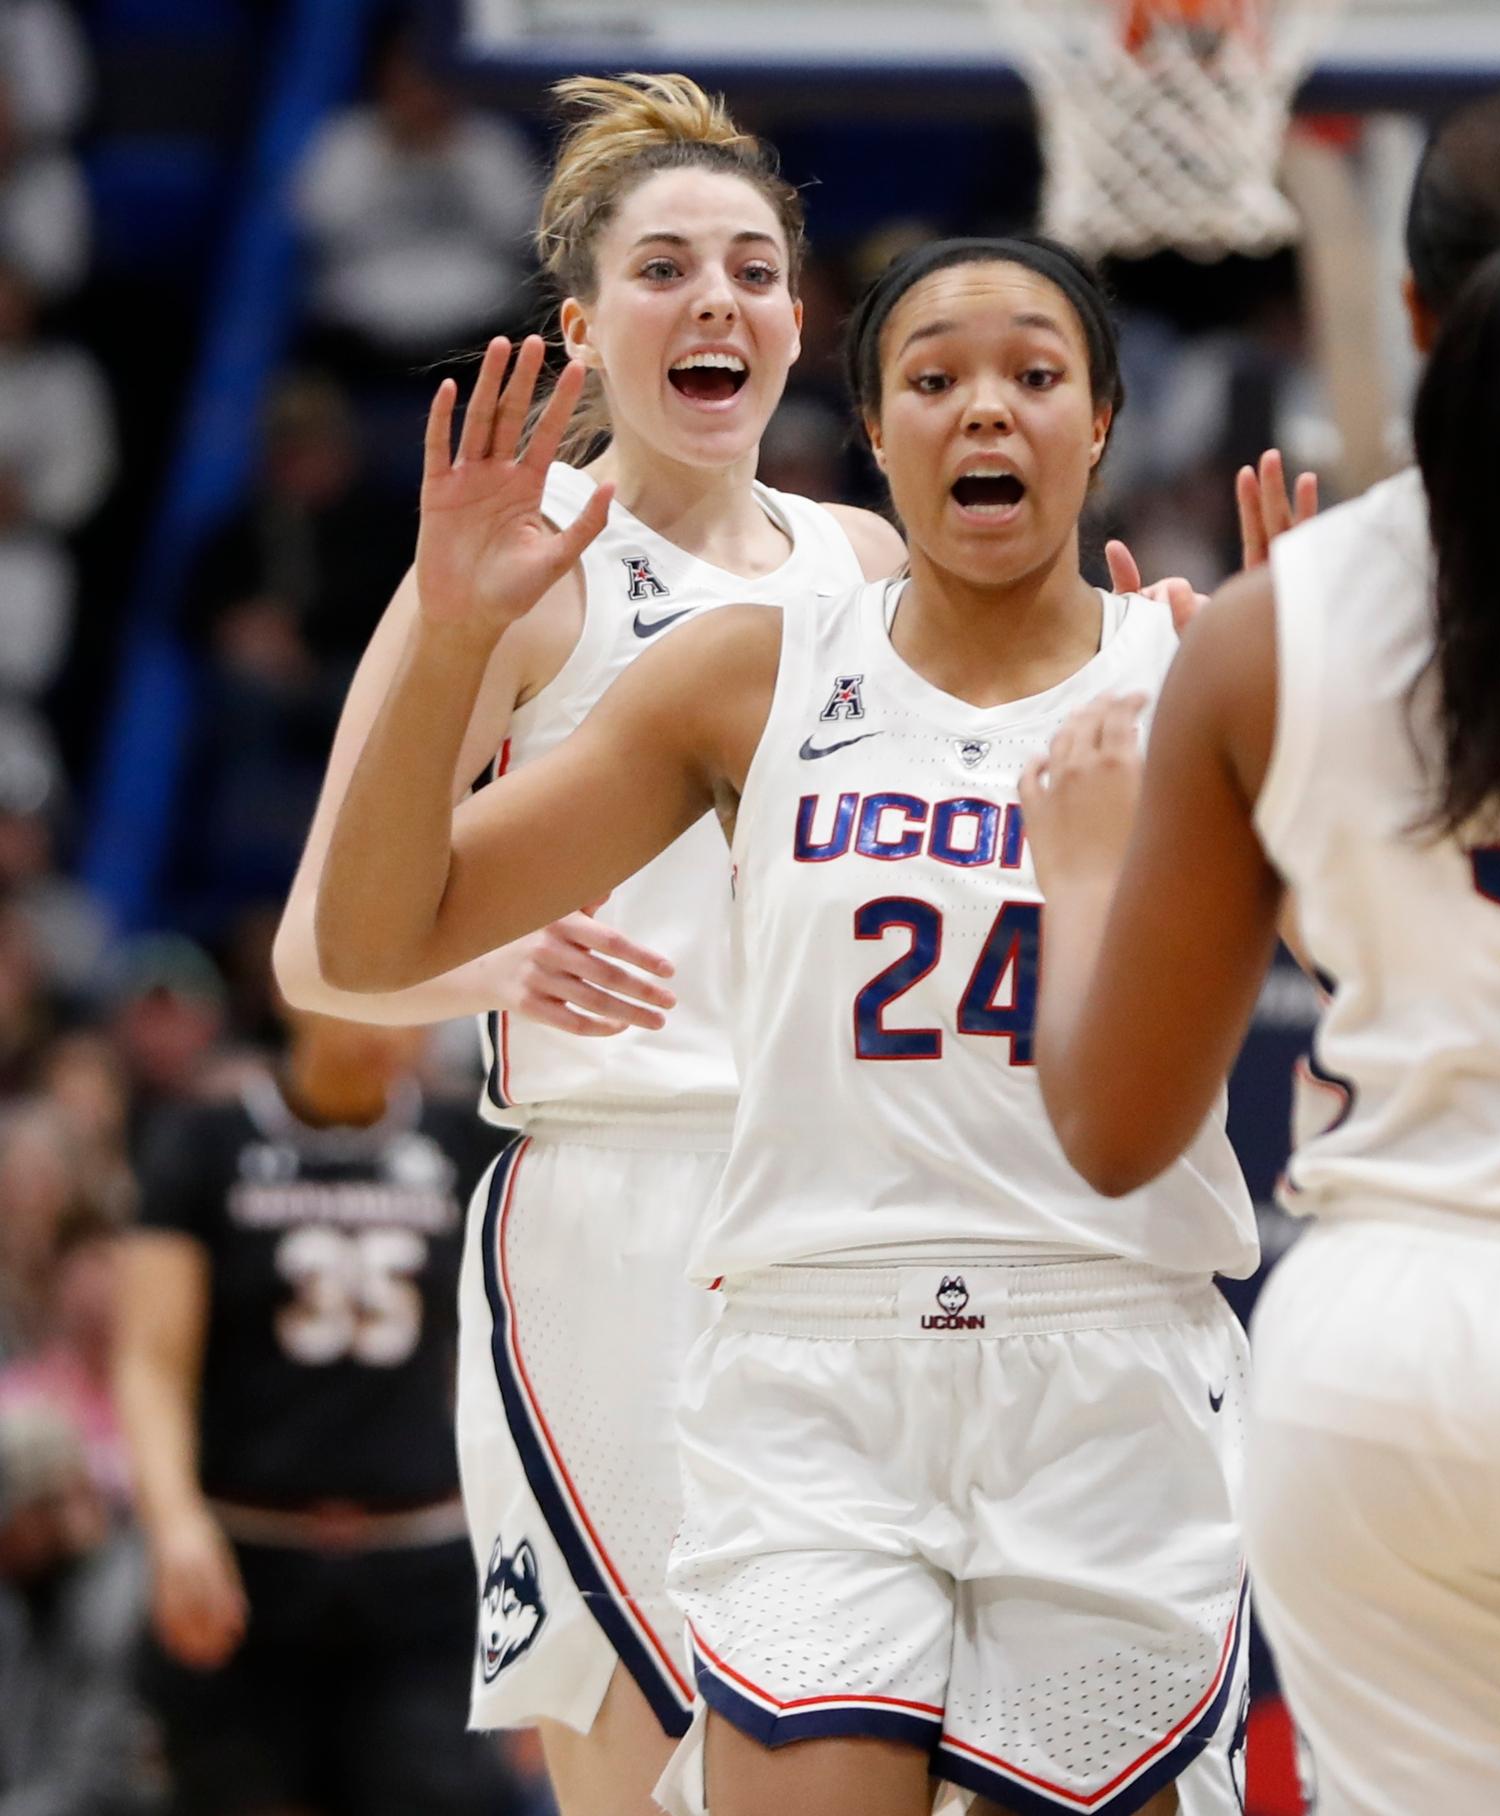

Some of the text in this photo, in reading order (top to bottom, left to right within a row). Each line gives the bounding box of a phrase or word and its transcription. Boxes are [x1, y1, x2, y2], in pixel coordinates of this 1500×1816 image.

[854, 896, 1045, 1066] 24
[275, 1226, 427, 1366] 35
[921, 1314, 985, 1330] UCONN
